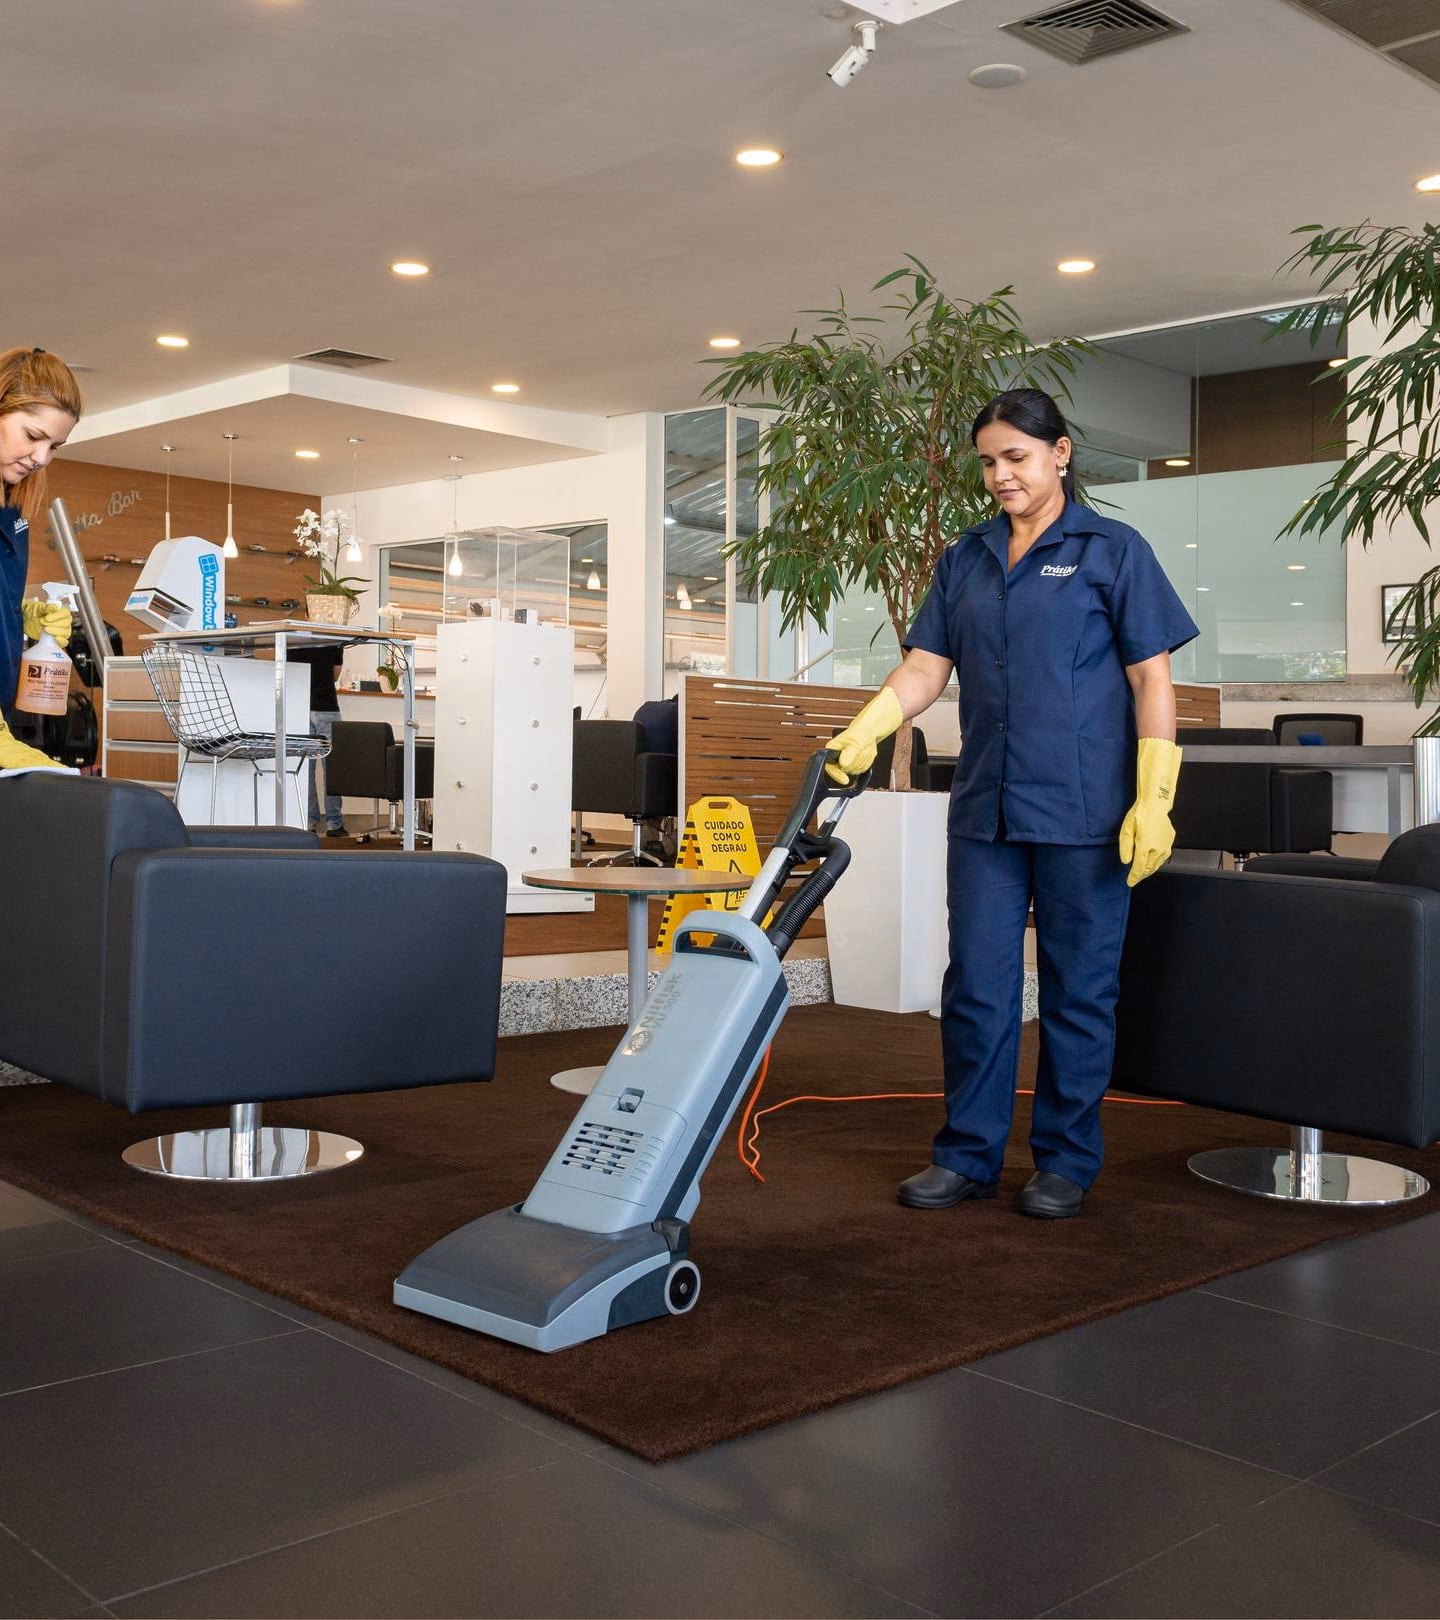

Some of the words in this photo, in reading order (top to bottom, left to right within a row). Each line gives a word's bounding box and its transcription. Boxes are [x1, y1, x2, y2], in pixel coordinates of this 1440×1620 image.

[107, 489, 143, 517] Bar
[704, 821, 744, 830] CUIDADO
[711, 844, 747, 853] DEGRAU
